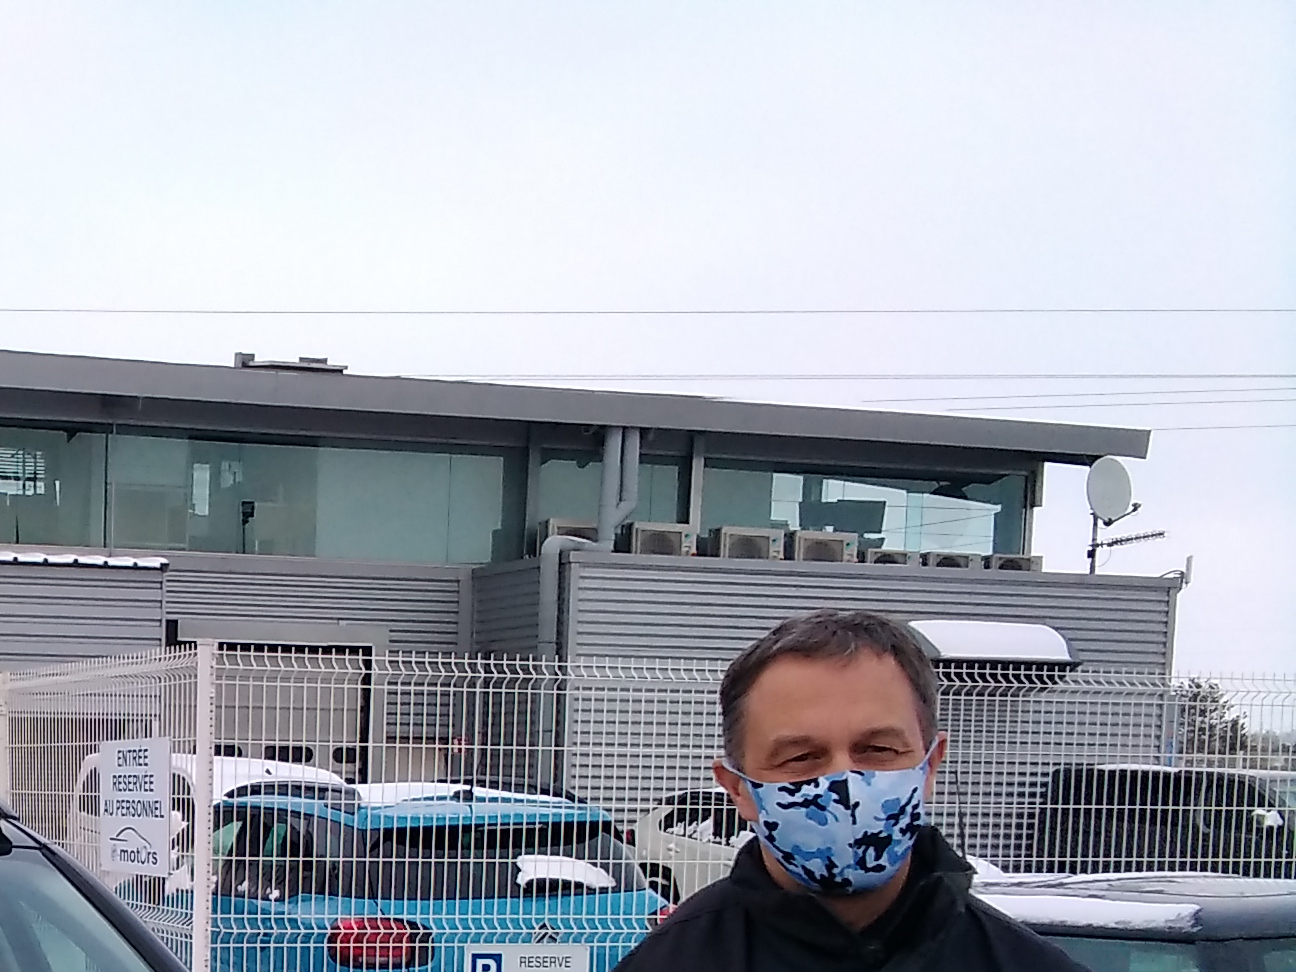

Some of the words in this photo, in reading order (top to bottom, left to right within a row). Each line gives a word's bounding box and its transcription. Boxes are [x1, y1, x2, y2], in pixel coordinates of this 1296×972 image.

[117, 745, 149, 767] ENTRÉE
[112, 770, 155, 792] RESERVÉE
[103, 799, 114, 817] AU
[115, 800, 165, 819] PERSONNEL
[519, 956, 572, 968] RESERVE
